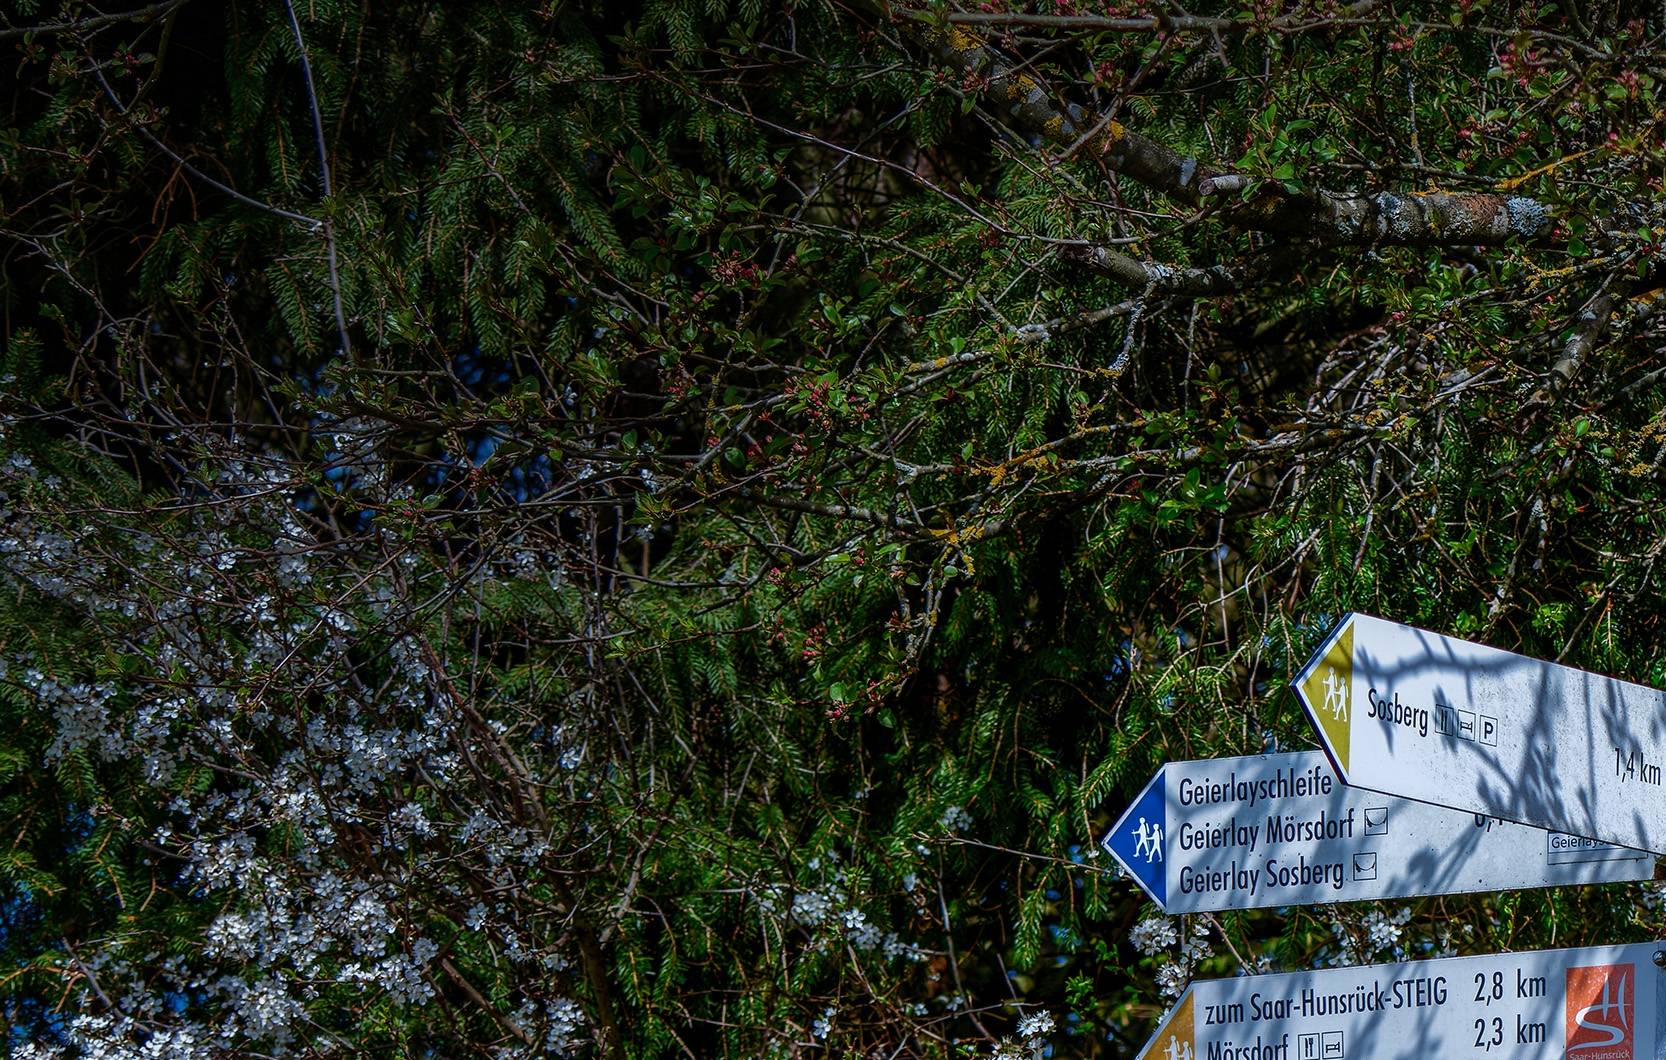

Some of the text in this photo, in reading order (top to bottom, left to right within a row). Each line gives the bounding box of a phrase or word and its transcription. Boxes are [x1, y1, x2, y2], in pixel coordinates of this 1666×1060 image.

[1367, 687, 1428, 738] Sosberg
[1614, 748, 1636, 784] 1,4
[1640, 754, 1662, 786] km
[1180, 766, 1332, 808] Geierlayschleife
[1180, 808, 1355, 853] Geierlay Mörsdorf
[1180, 855, 1344, 896] Geierlay Sosberg
[1205, 967, 1546, 1026] zum Saar-Hunsrück-STEIG 2,8 km
[1473, 1016, 1504, 1053] 2,3
[1516, 1013, 1546, 1045] km
